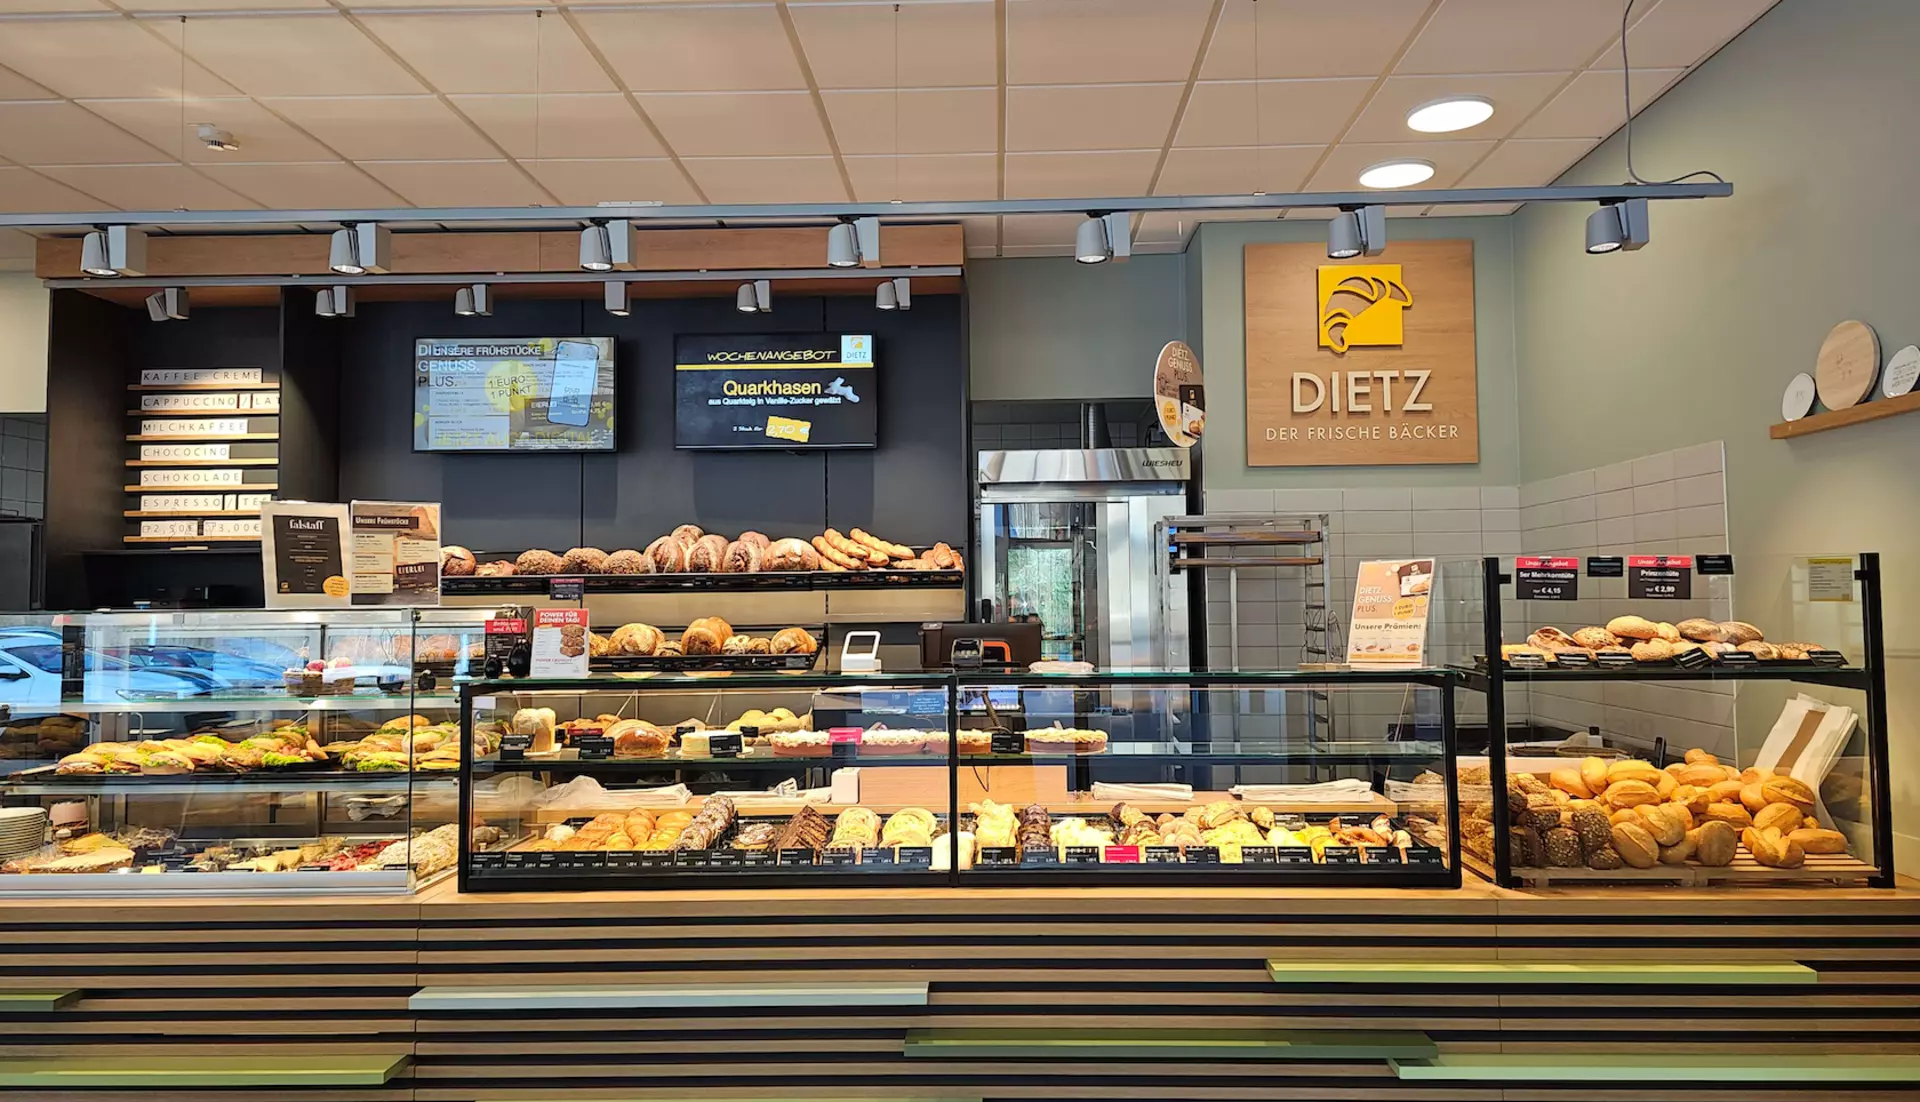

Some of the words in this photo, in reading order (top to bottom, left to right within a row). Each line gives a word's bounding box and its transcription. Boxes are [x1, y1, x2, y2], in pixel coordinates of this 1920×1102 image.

[476, 344, 541, 356] FRÜHSTÜCKE
[706, 350, 837, 361] WOCHENANGEBOT
[846, 351, 867, 359] DIETZ
[418, 359, 480, 371] GENUSS.
[418, 375, 457, 388] PLUS.
[496, 375, 526, 387] EURO
[723, 381, 821, 396] Quarkhasen
[1292, 369, 1433, 413] DIETZ
[143, 397, 236, 407] CAPPUCCINO
[143, 422, 245, 431] MILCHKAFFEE
[1265, 427, 1299, 441] DER
[1307, 426, 1381, 441] FRISCHE
[1388, 422, 1459, 439] BÄCKER
[143, 447, 228, 457] CHOCOCINO
[143, 472, 240, 482] SCHOKOLADE
[143, 498, 220, 507] ESPRESSO
[289, 519, 325, 530] falstaff
